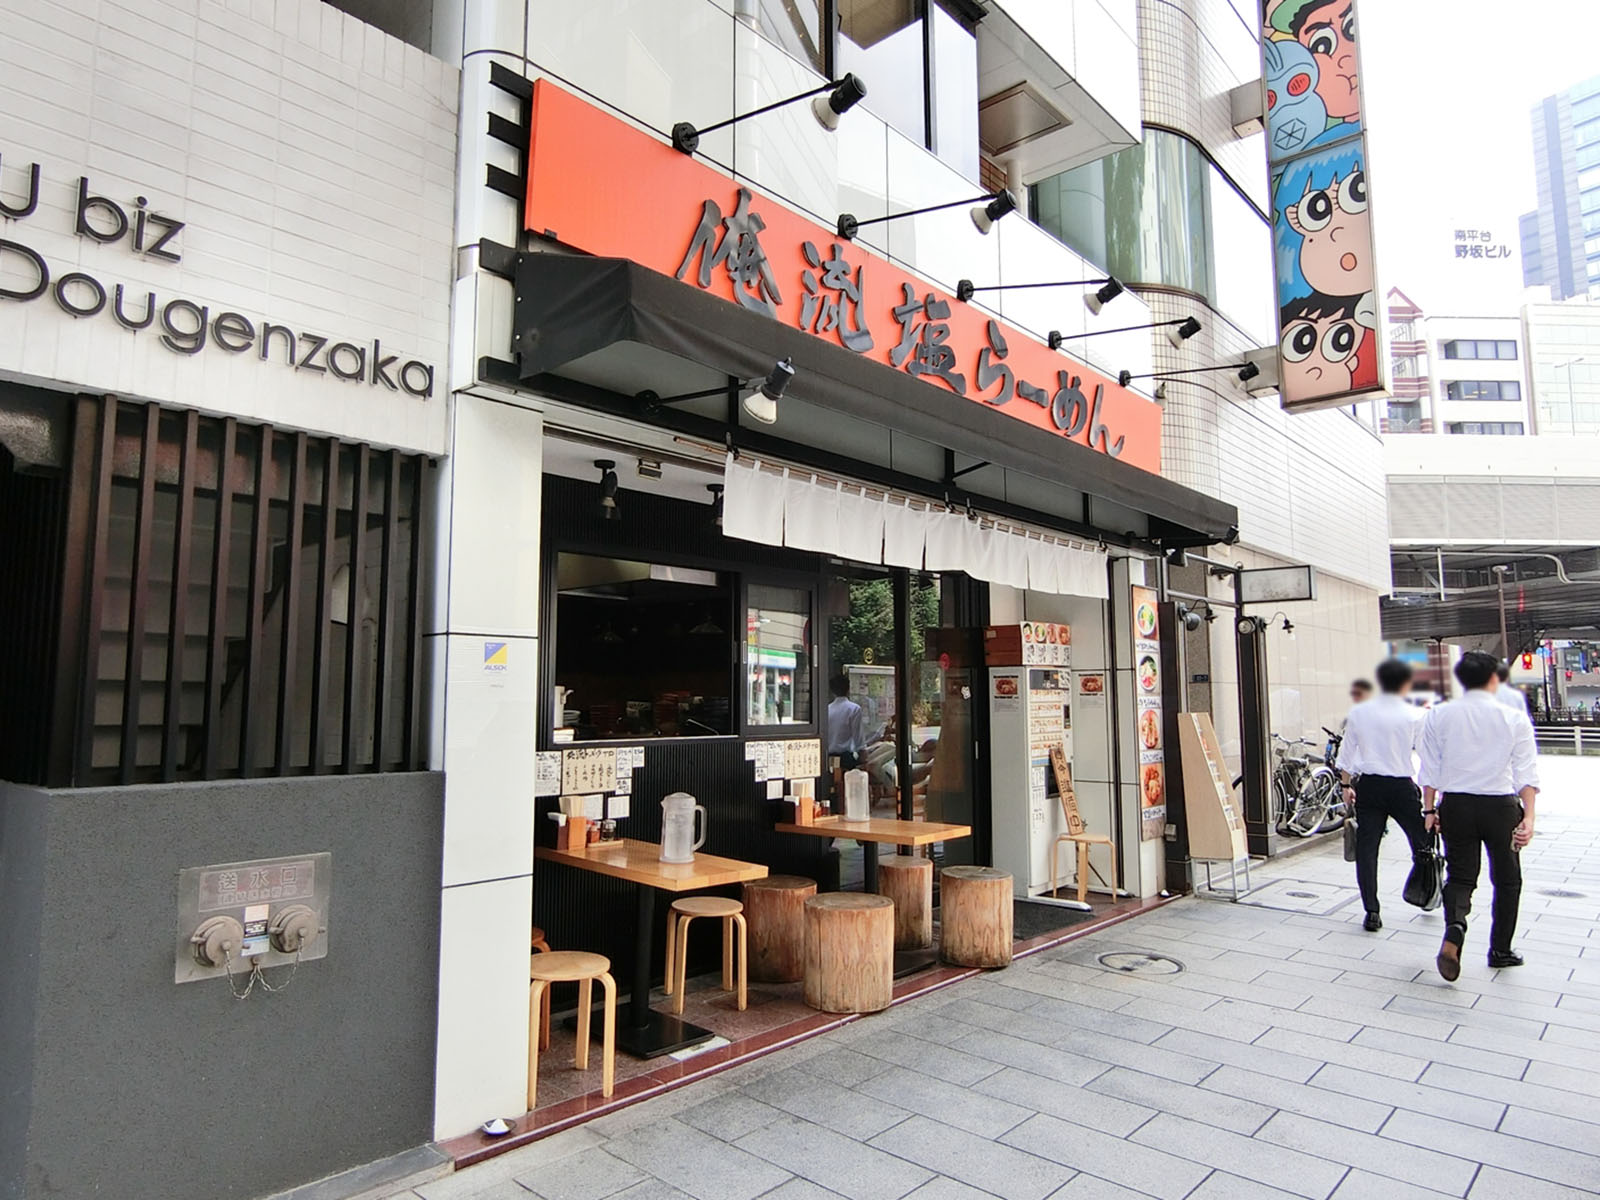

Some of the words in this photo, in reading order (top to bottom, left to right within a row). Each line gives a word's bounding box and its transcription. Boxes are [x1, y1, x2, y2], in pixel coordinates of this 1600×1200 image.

[75, 176, 186, 263] biz
[1454, 229, 1492, 242] 南平台
[1455, 244, 1512, 259] 野坂ビル
[0, 238, 435, 399] Dougenzaka
[676, 187, 1125, 458] 俺流塩らーめん
[217, 866, 298, 893] 送水口
